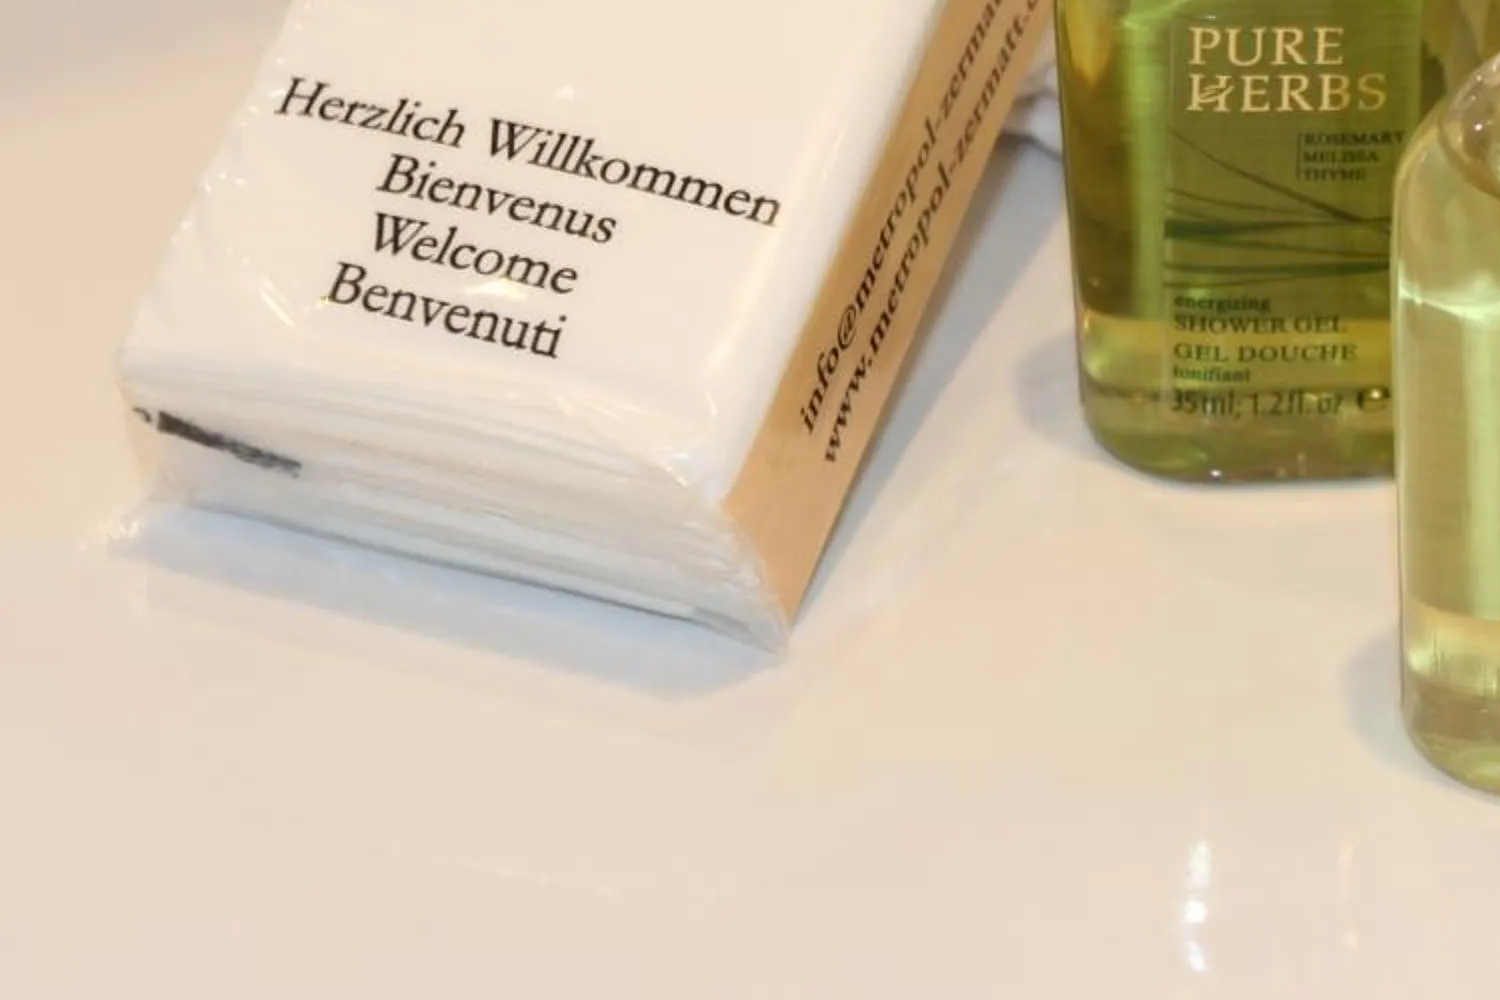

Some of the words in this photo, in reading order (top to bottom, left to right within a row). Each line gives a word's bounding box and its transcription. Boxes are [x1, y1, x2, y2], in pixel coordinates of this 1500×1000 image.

[1188, 26, 1344, 66] PURE
[1186, 73, 1388, 113] HERBS
[274, 77, 467, 148] Herzlich
[488, 117, 782, 228] Willkommen
[1302, 130, 1407, 146] ROSEMARY
[1302, 150, 1379, 165] MELISSA
[1302, 167, 1367, 182] THYME
[376, 153, 617, 244] Bienvenus
[372, 211, 578, 295] Welcome
[325, 262, 567, 359] Benvenuti
[1174, 295, 1271, 313] energizing
[1174, 315, 1288, 334] SHOWER
[1294, 315, 1347, 334] GEL
[1174, 342, 1230, 363] GEL
[1238, 343, 1358, 362] DOUCHE
